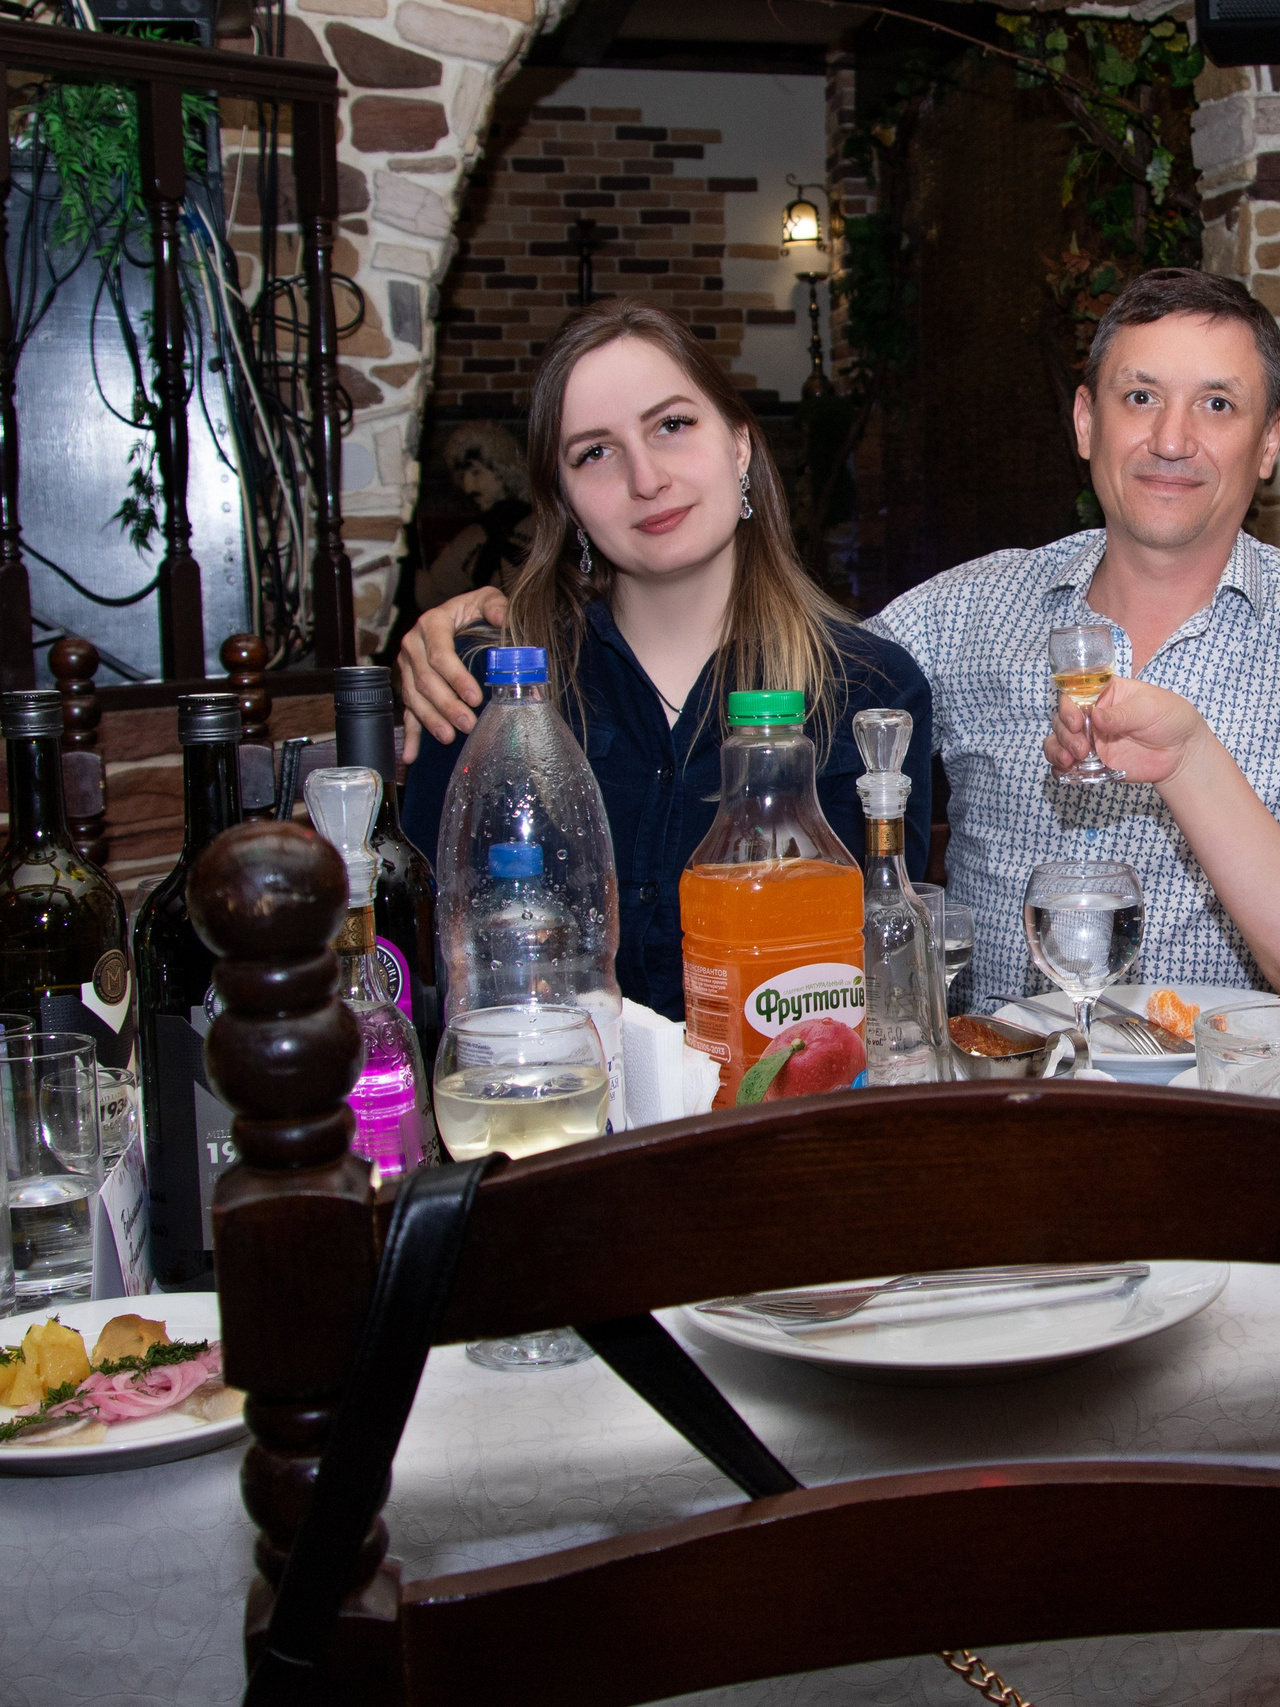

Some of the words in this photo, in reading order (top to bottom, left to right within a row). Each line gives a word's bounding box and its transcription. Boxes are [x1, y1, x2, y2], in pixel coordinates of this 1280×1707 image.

[805, 979, 844, 990] НАТУРАЛЬНЫЙ
[755, 987, 865, 1026] Фрутмотив
[206, 1142, 237, 1164] 19
